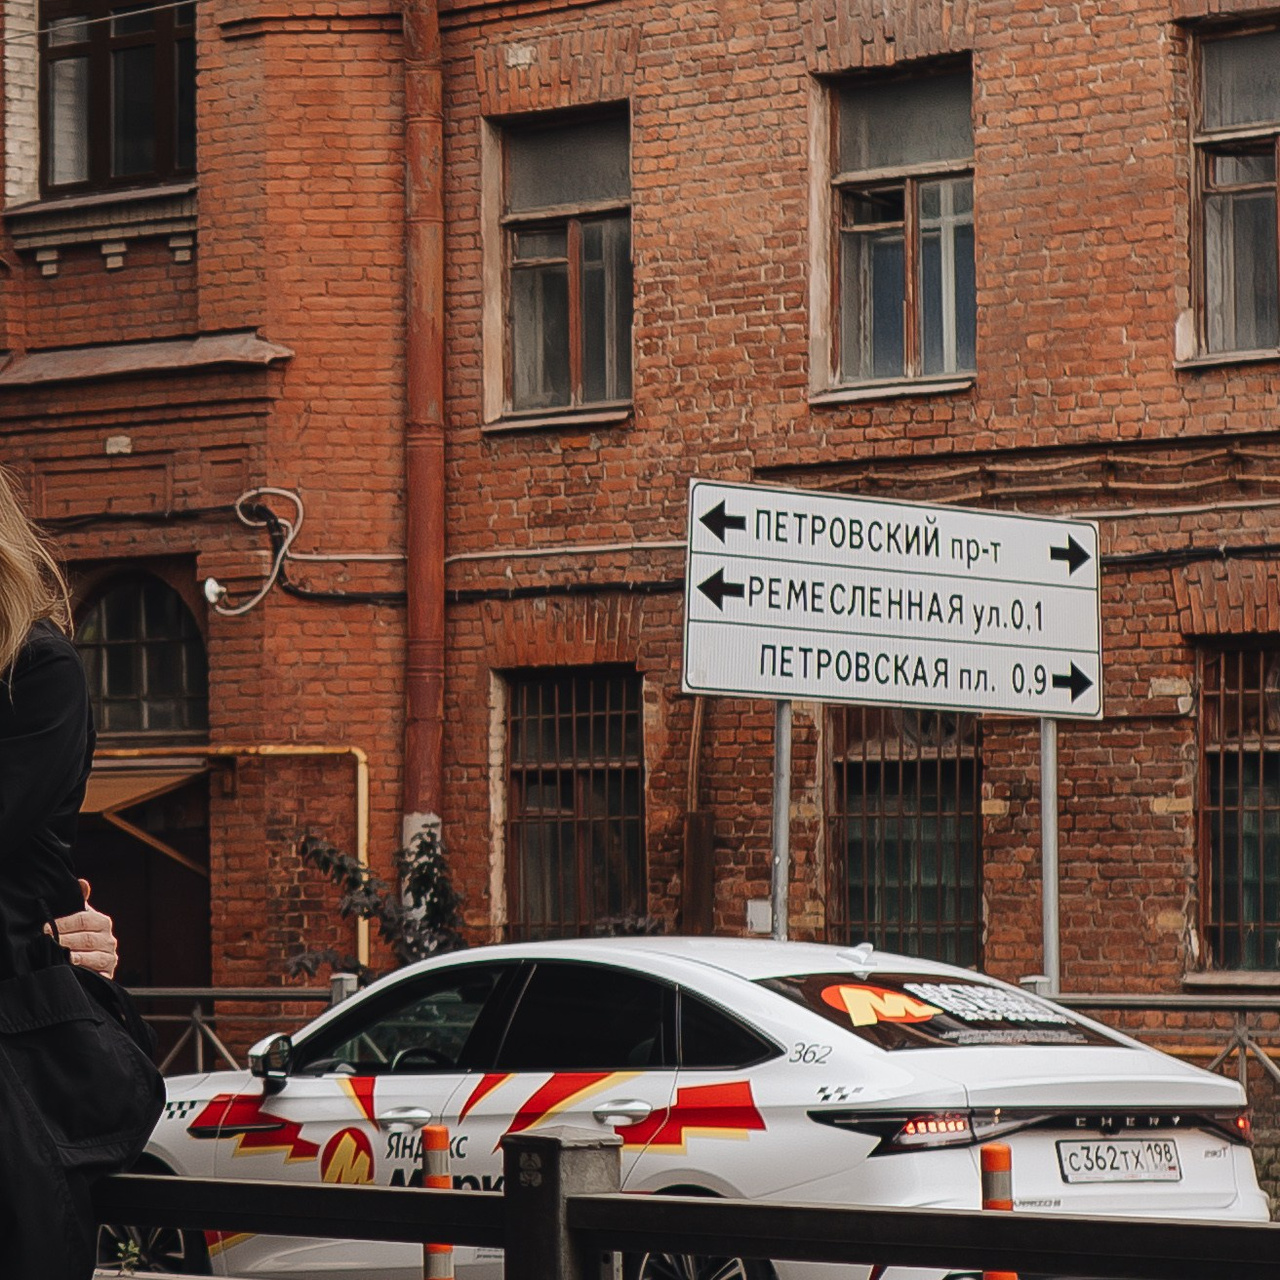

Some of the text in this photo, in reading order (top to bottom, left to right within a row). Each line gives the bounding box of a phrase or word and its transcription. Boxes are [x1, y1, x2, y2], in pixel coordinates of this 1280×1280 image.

[755, 508, 1002, 570] ПЕТРОВСКИЙ пр-т
[748, 575, 964, 625] РЕМЕСЛЕННАЯ
[760, 643, 1047, 699] ПЕТРОВСКАЯ пл. 0,9
[788, 1042, 833, 1064] 362
[1075, 1115, 1180, 1127] CHERY
